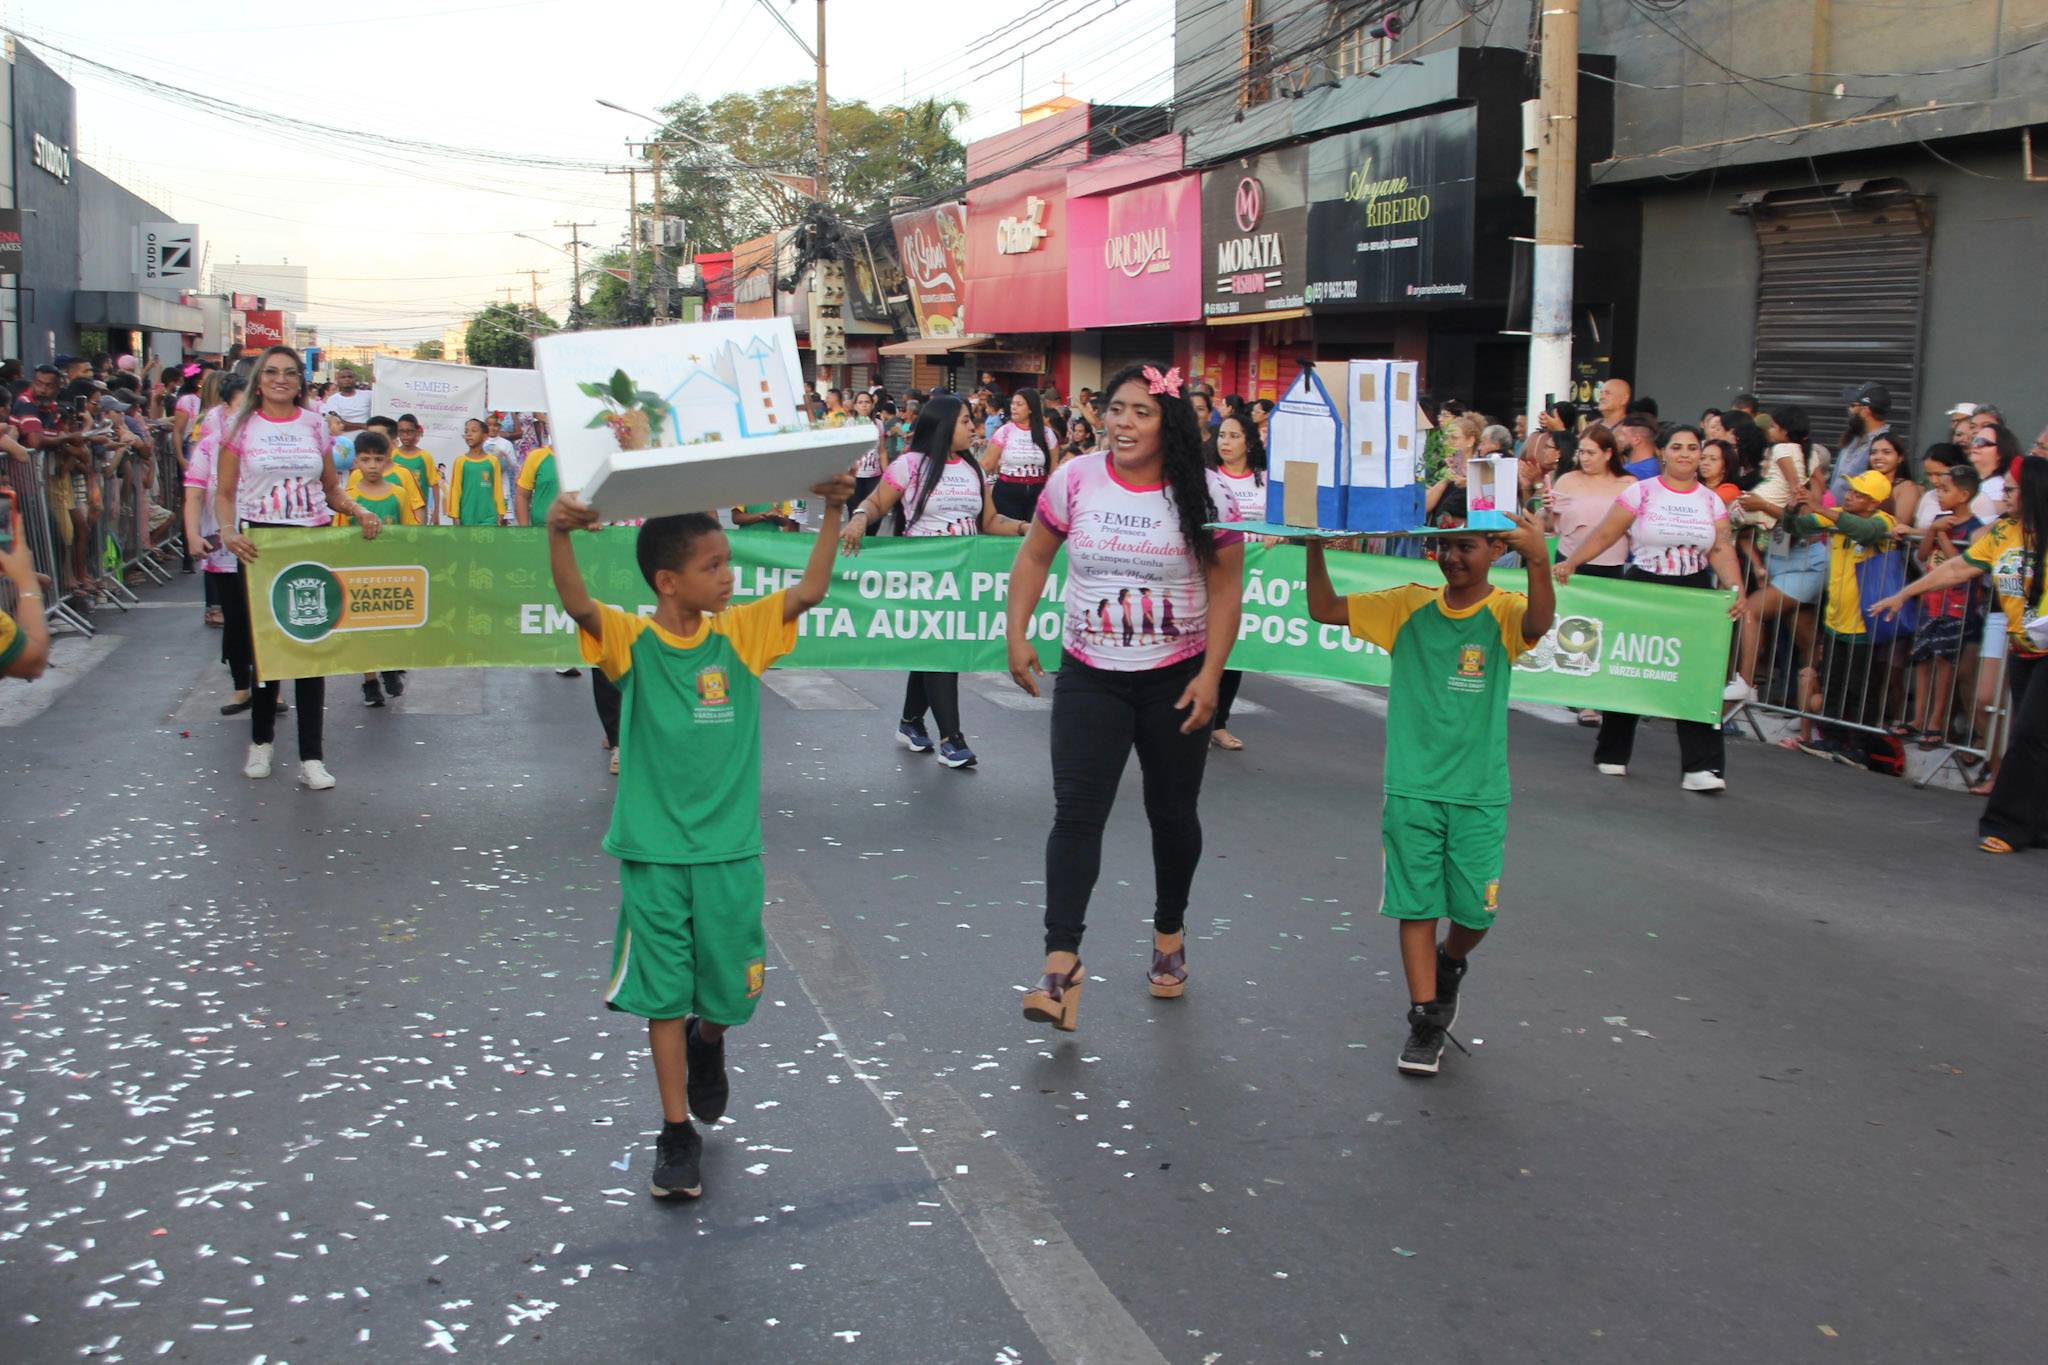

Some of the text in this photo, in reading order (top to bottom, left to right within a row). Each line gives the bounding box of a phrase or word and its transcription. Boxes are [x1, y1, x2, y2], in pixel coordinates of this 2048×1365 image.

[1344, 157, 1409, 212] Aryane
[1367, 195, 1430, 227] RIBEIRO
[147, 233, 156, 278] STUDIO
[1105, 227, 1170, 277] ORIGINAL
[1218, 232, 1283, 275] MORATA
[413, 380, 450, 393] EMEB
[1104, 511, 1151, 529] EMEB
[1072, 531, 1094, 549] Rita
[1101, 525, 1146, 537] Professora
[1092, 553, 1131, 565] Campos
[1132, 557, 1164, 568] Cunha
[1126, 569, 1164, 582] Mulher
[350, 585, 414, 601] VÁRZEA
[351, 600, 415, 613] GRANDE
[1610, 631, 1681, 668] ANOS
[1609, 663, 1678, 683] VÁRZEA GRANDE
